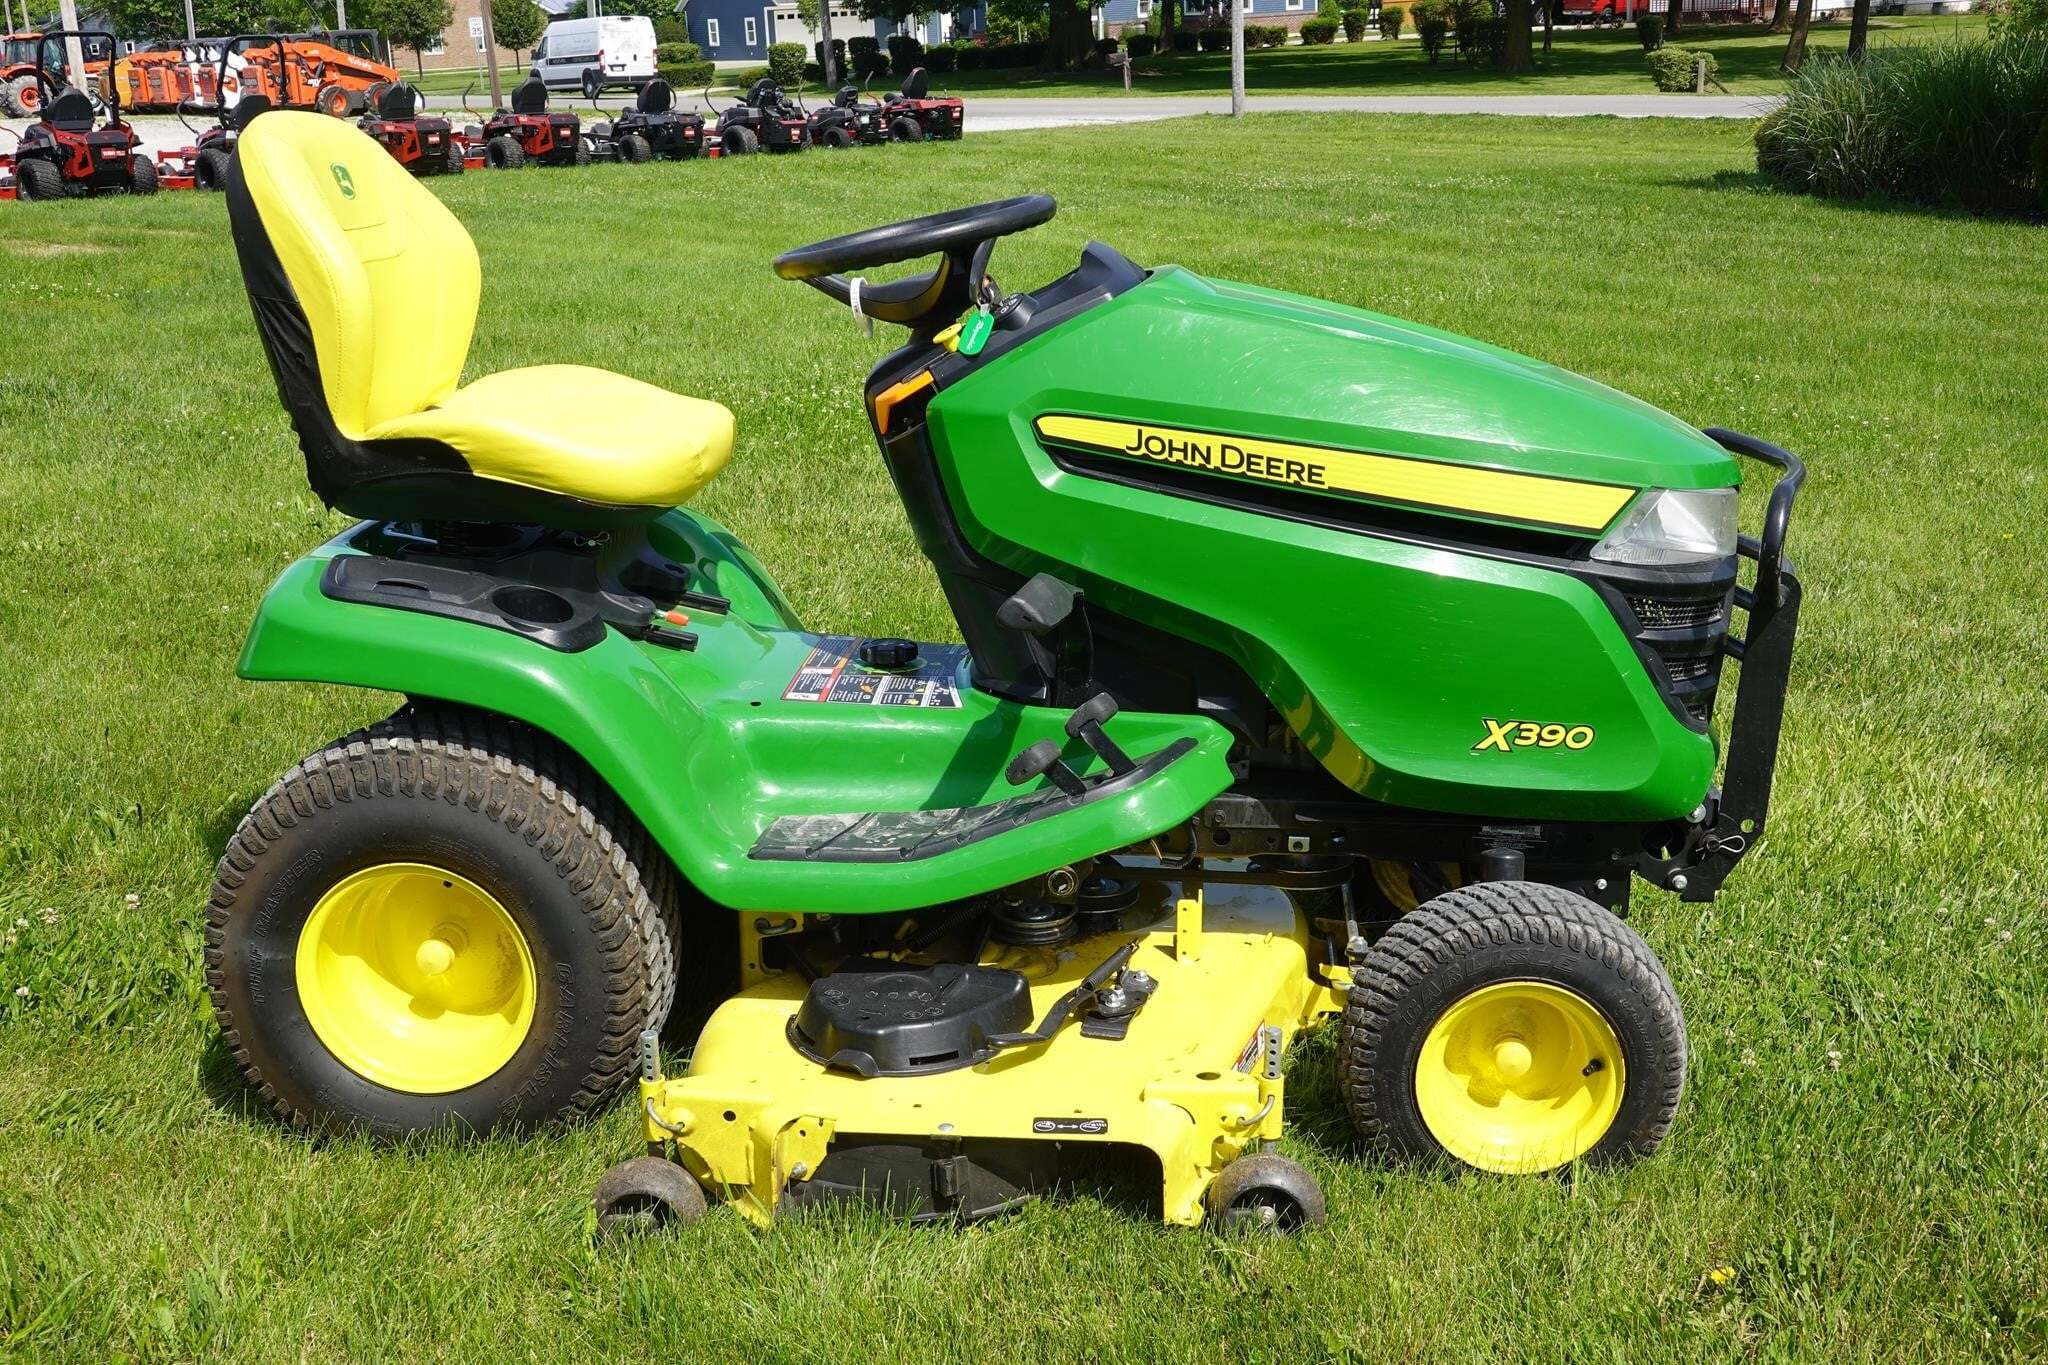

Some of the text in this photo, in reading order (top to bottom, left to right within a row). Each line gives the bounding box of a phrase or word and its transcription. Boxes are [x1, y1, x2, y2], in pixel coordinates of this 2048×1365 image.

[1125, 429, 1326, 486] JOHN DEERE
[1471, 719, 1596, 752] X390
[1401, 947, 1581, 1026] CARLISLE
[502, 962, 576, 1117] CARLISLE
